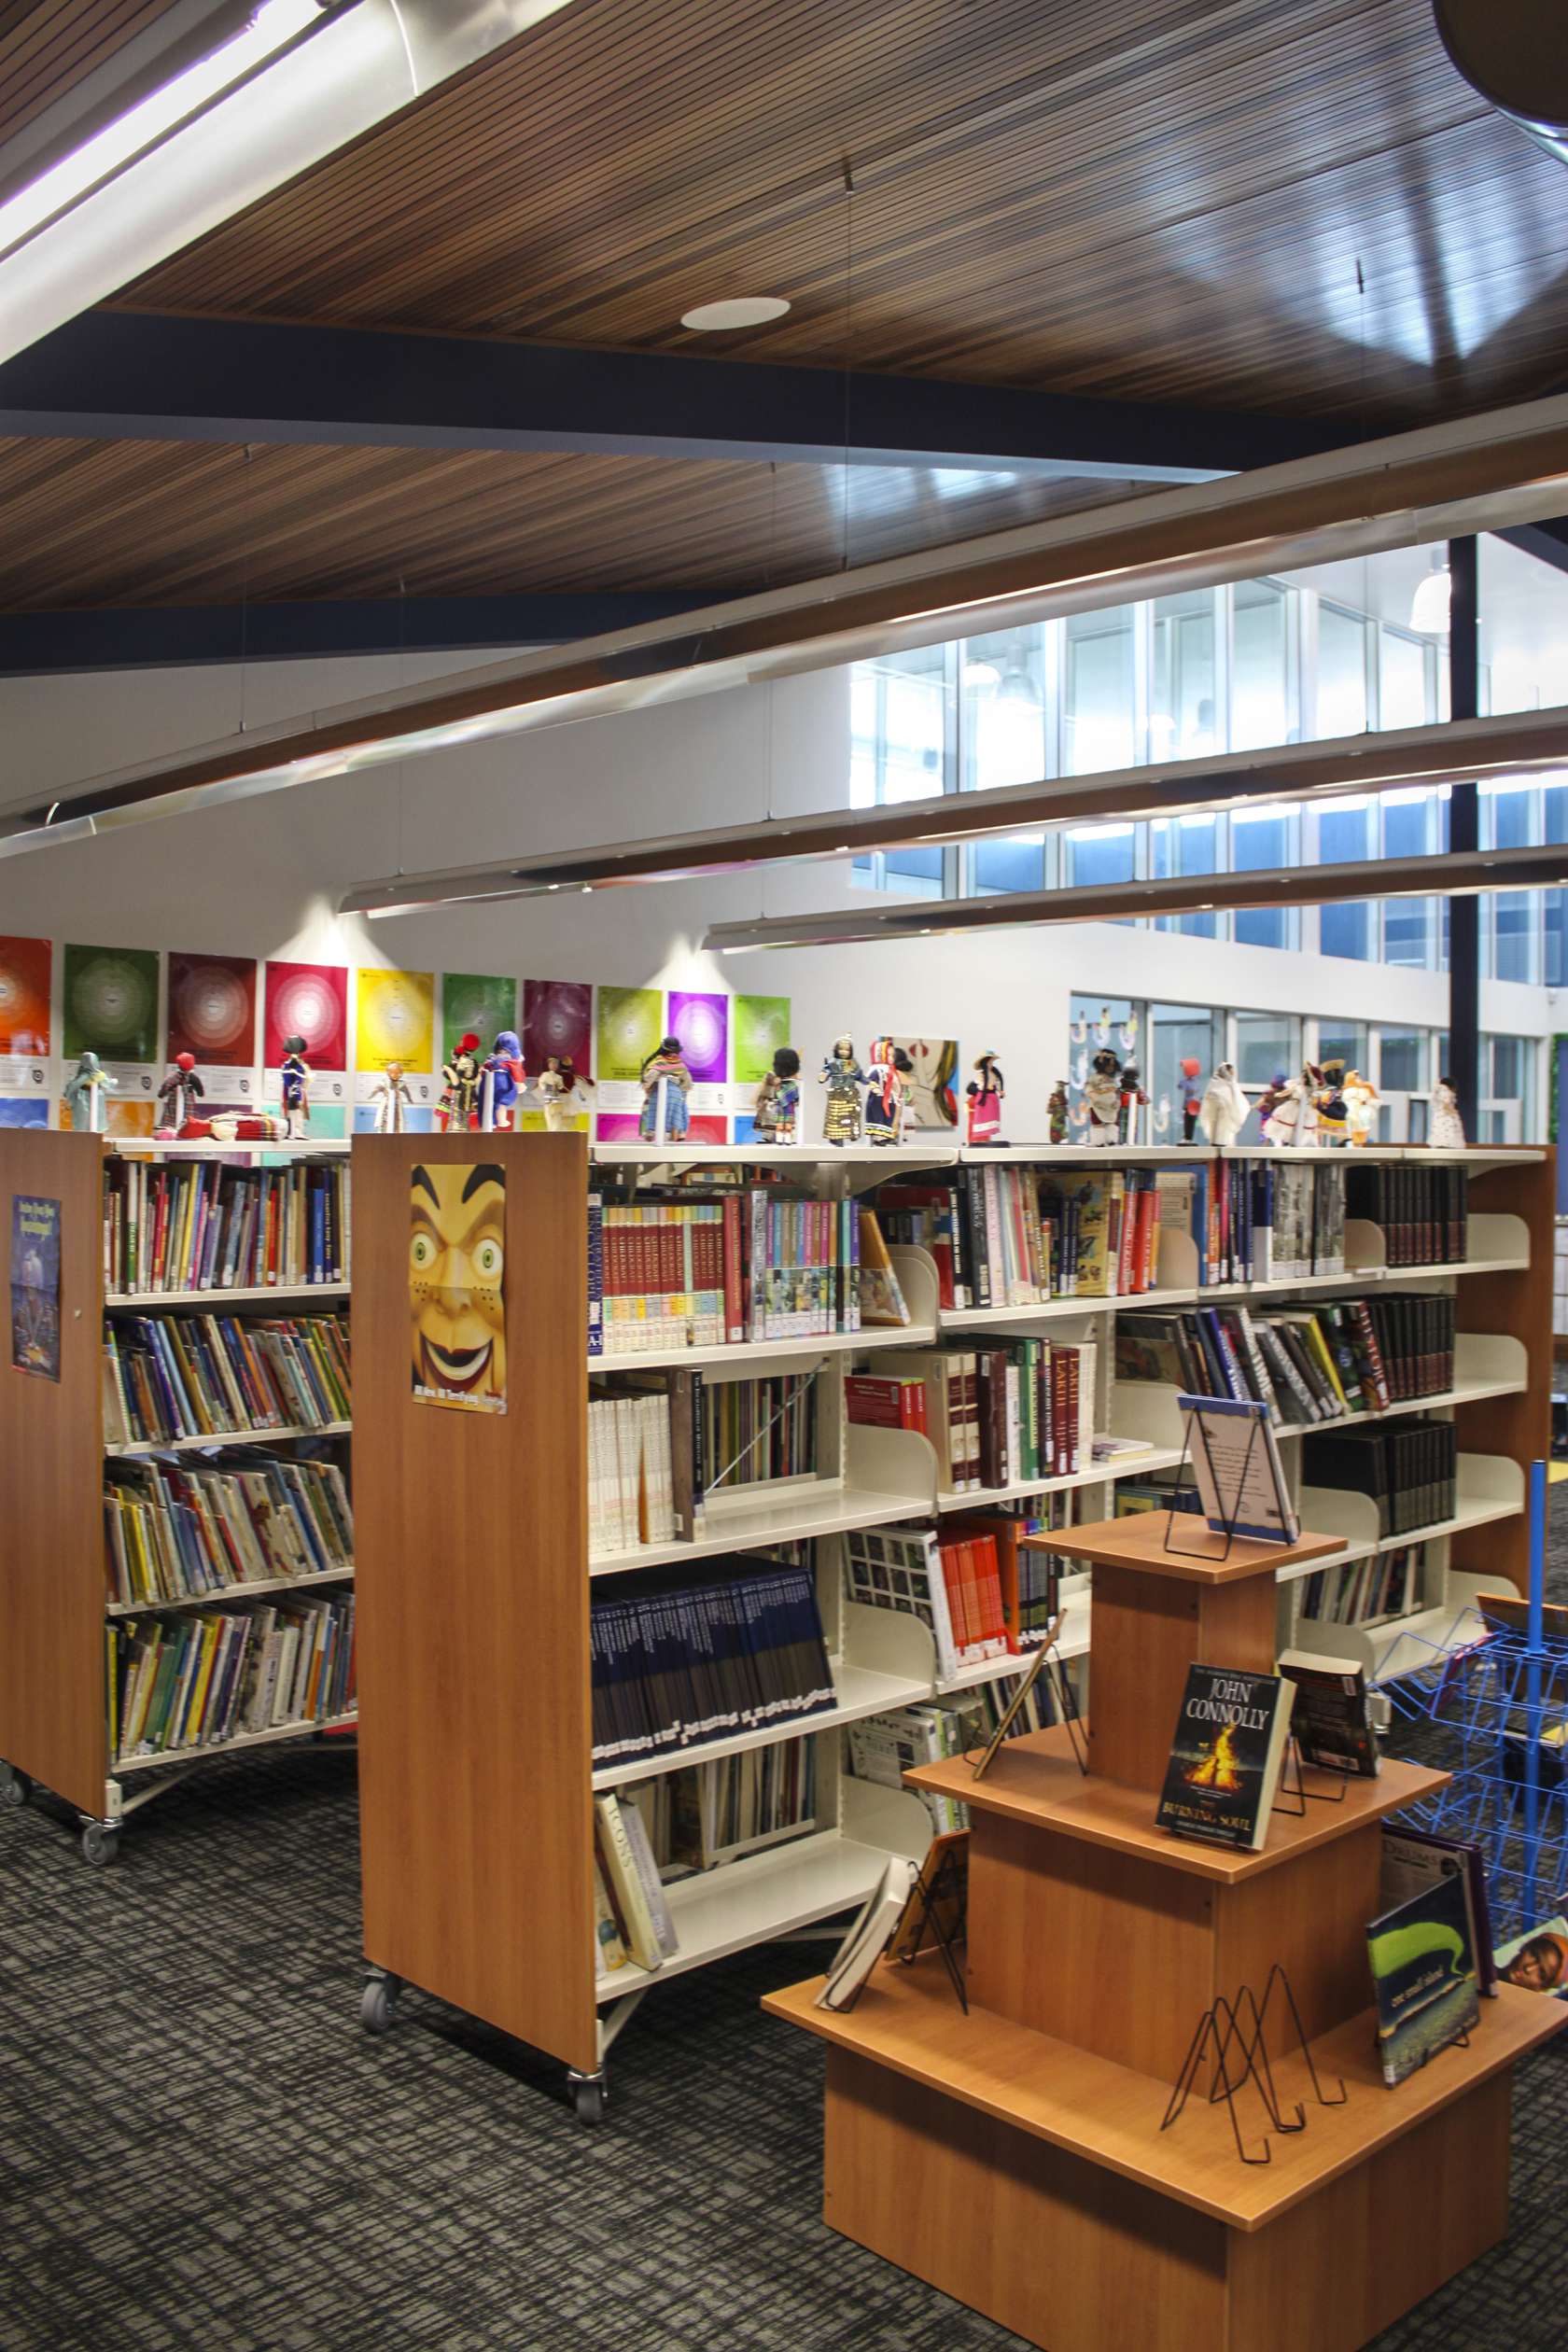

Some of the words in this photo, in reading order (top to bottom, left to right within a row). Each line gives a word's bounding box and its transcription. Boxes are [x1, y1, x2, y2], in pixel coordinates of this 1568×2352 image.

[1210, 1678, 1253, 1702] JOHN
[1186, 1698, 1269, 1730] CONNOLLY
[608, 1808, 631, 1868] ICONS
